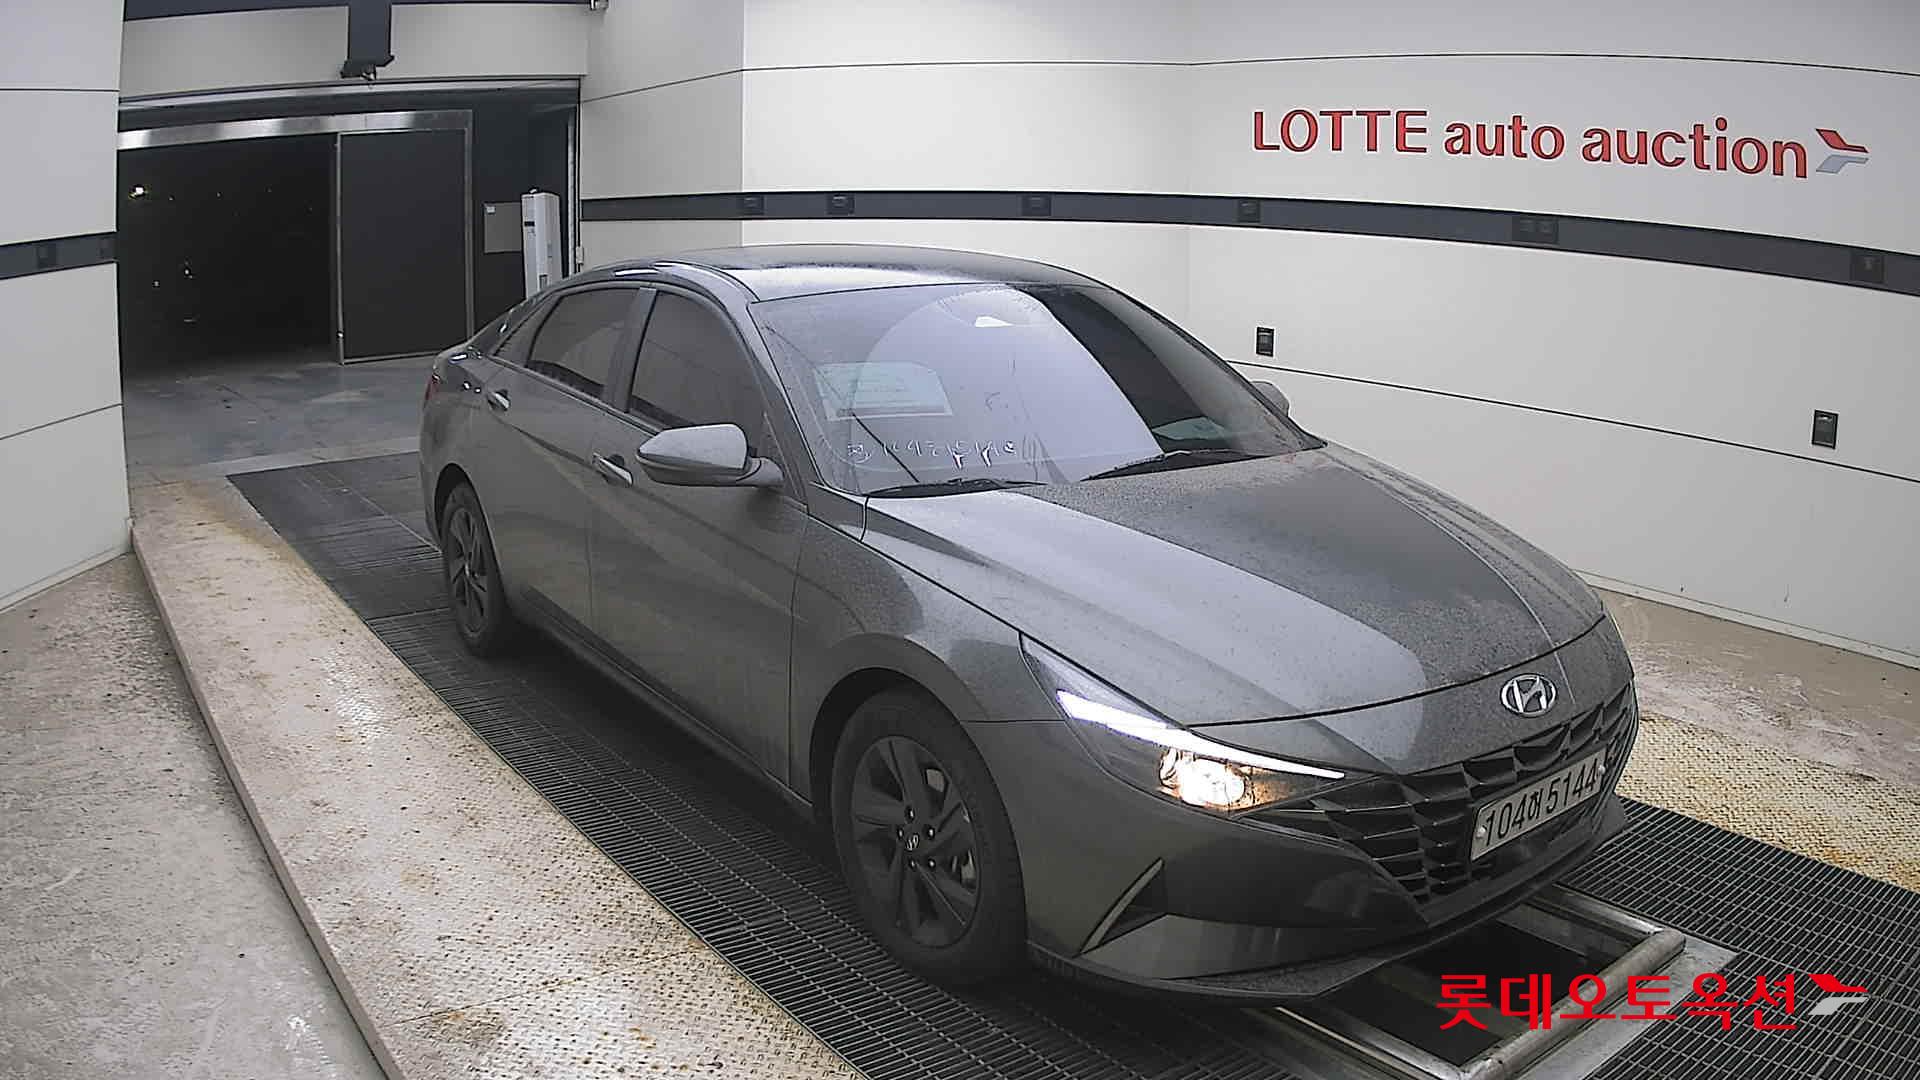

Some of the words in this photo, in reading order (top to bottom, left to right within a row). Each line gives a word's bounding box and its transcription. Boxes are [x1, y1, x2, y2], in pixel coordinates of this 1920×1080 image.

[1253, 109, 1428, 153] LOTTE
[1444, 114, 1566, 159] auto
[1582, 117, 1809, 178] auction
